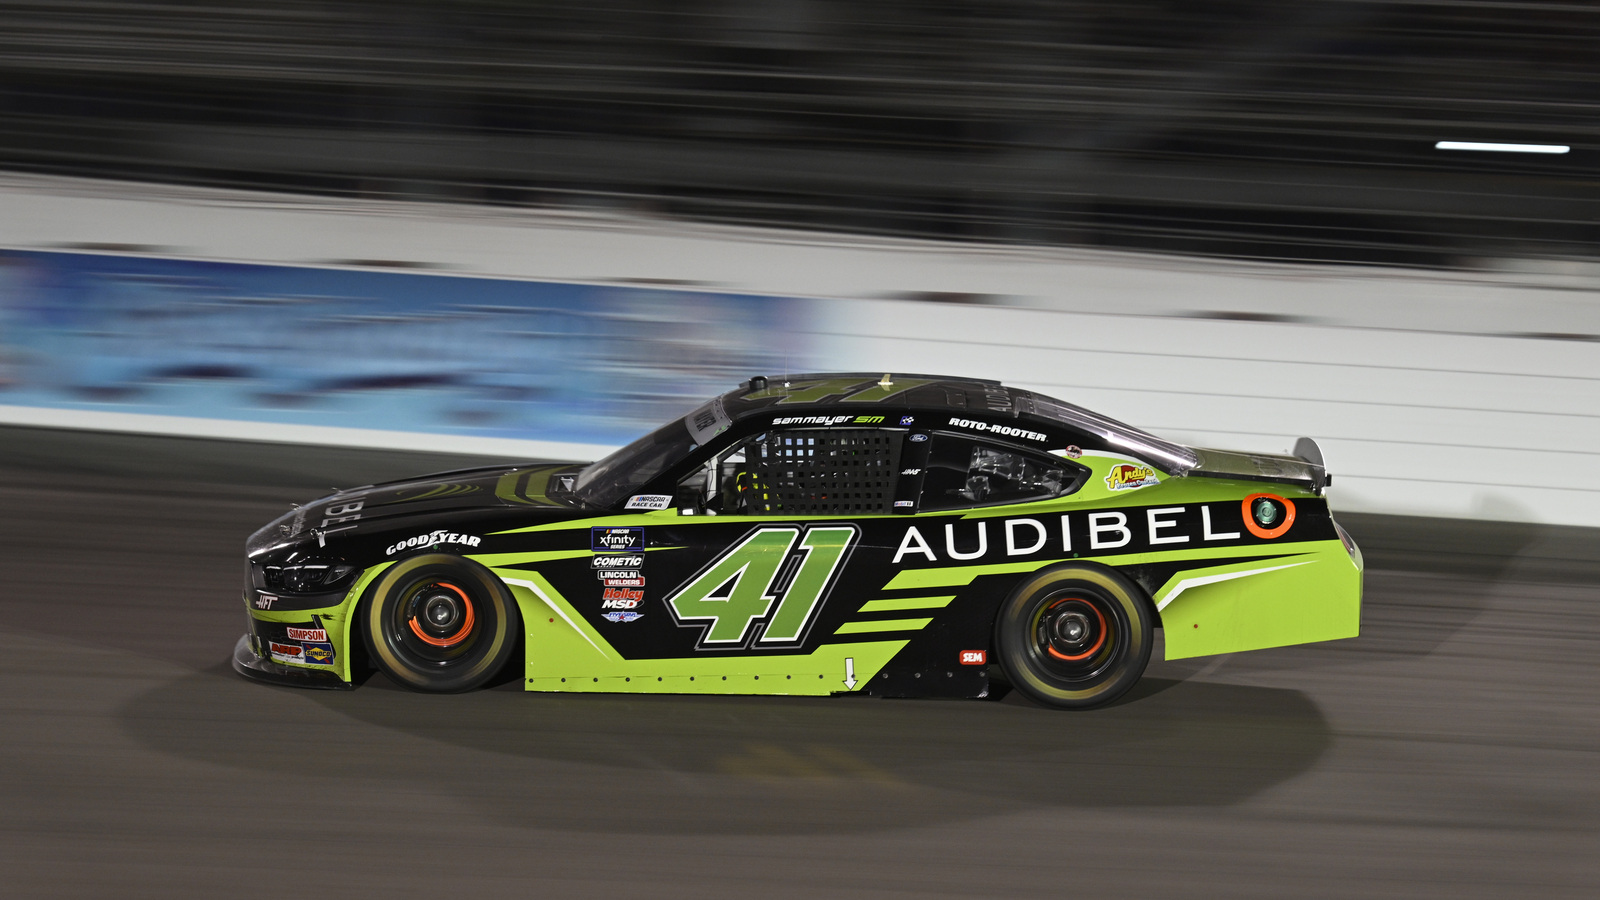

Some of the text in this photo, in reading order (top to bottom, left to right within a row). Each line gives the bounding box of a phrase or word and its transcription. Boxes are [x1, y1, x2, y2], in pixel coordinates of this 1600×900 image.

[949, 417, 1047, 442] ROTO-ROOTER
[1106, 465, 1154, 489] Andy's
[600, 534, 636, 547] xfinity
[892, 505, 1241, 564] AUDIBEL
[600, 571, 637, 579] LINCOLN
[666, 525, 858, 647] 41
[603, 588, 645, 602] Holley
[601, 599, 638, 609] MSD
[289, 629, 324, 641] SIMPSON
[271, 643, 302, 656] ARP
[963, 652, 983, 663] SEM
